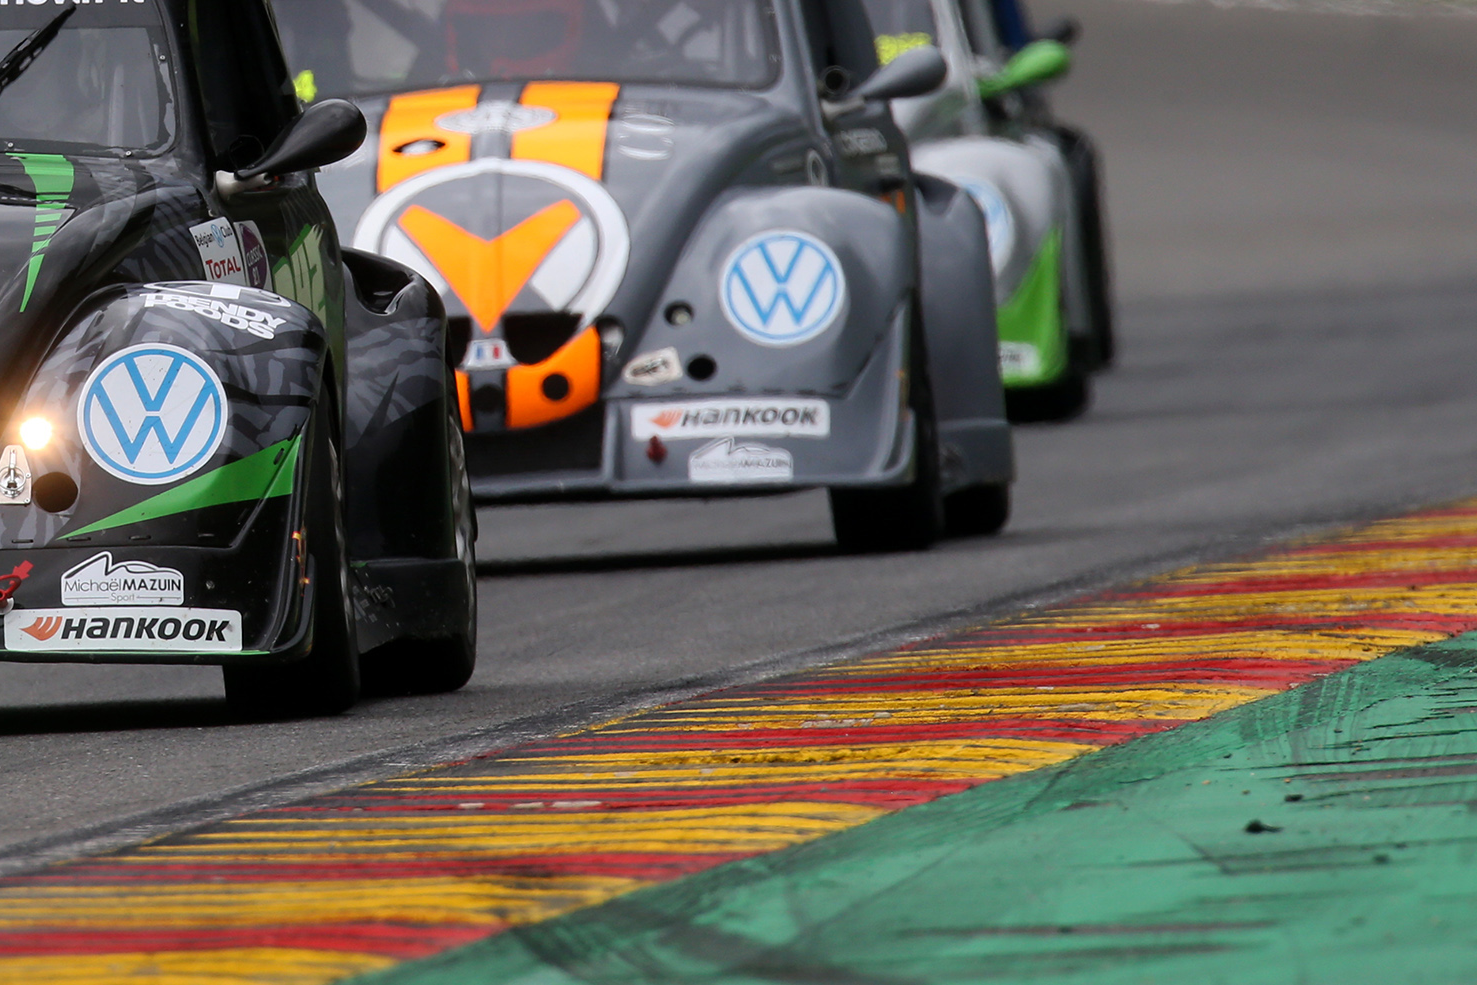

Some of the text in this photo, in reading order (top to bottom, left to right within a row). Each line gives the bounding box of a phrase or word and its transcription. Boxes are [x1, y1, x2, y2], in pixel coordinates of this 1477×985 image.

[205, 256, 241, 280] TOTAL
[140, 293, 286, 329] TRENDY
[144, 296, 275, 340] FOODS
[122, 579, 181, 591] MAZUIN
[111, 592, 135, 603] Sport
